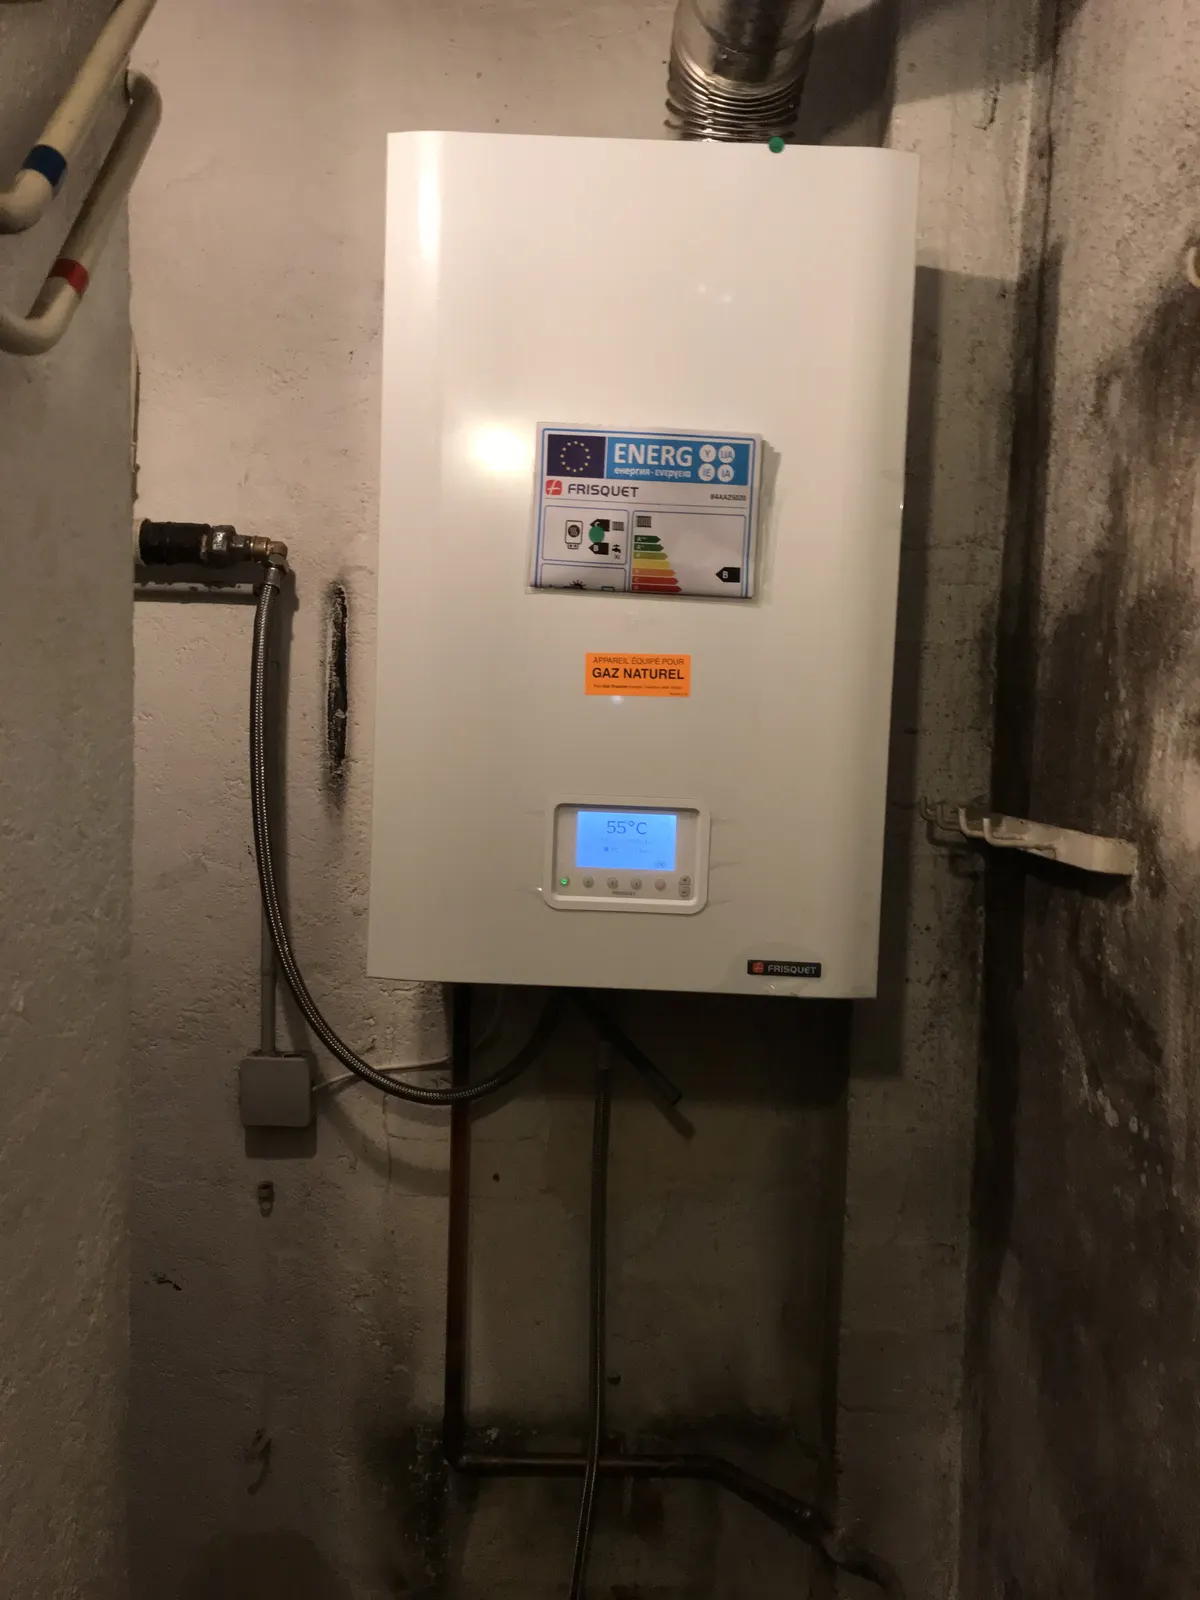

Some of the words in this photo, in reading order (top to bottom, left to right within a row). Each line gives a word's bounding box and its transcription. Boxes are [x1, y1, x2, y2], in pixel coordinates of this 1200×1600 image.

[614, 443, 693, 467] ENERG
[567, 484, 639, 498] FRISQUET
[722, 570, 729, 579] B
[592, 656, 629, 665] APPAREIL
[592, 667, 619, 678] GAZ
[623, 668, 685, 680] NATUREL
[606, 820, 648, 835] 55°C
[767, 964, 817, 974] FRISQUET
